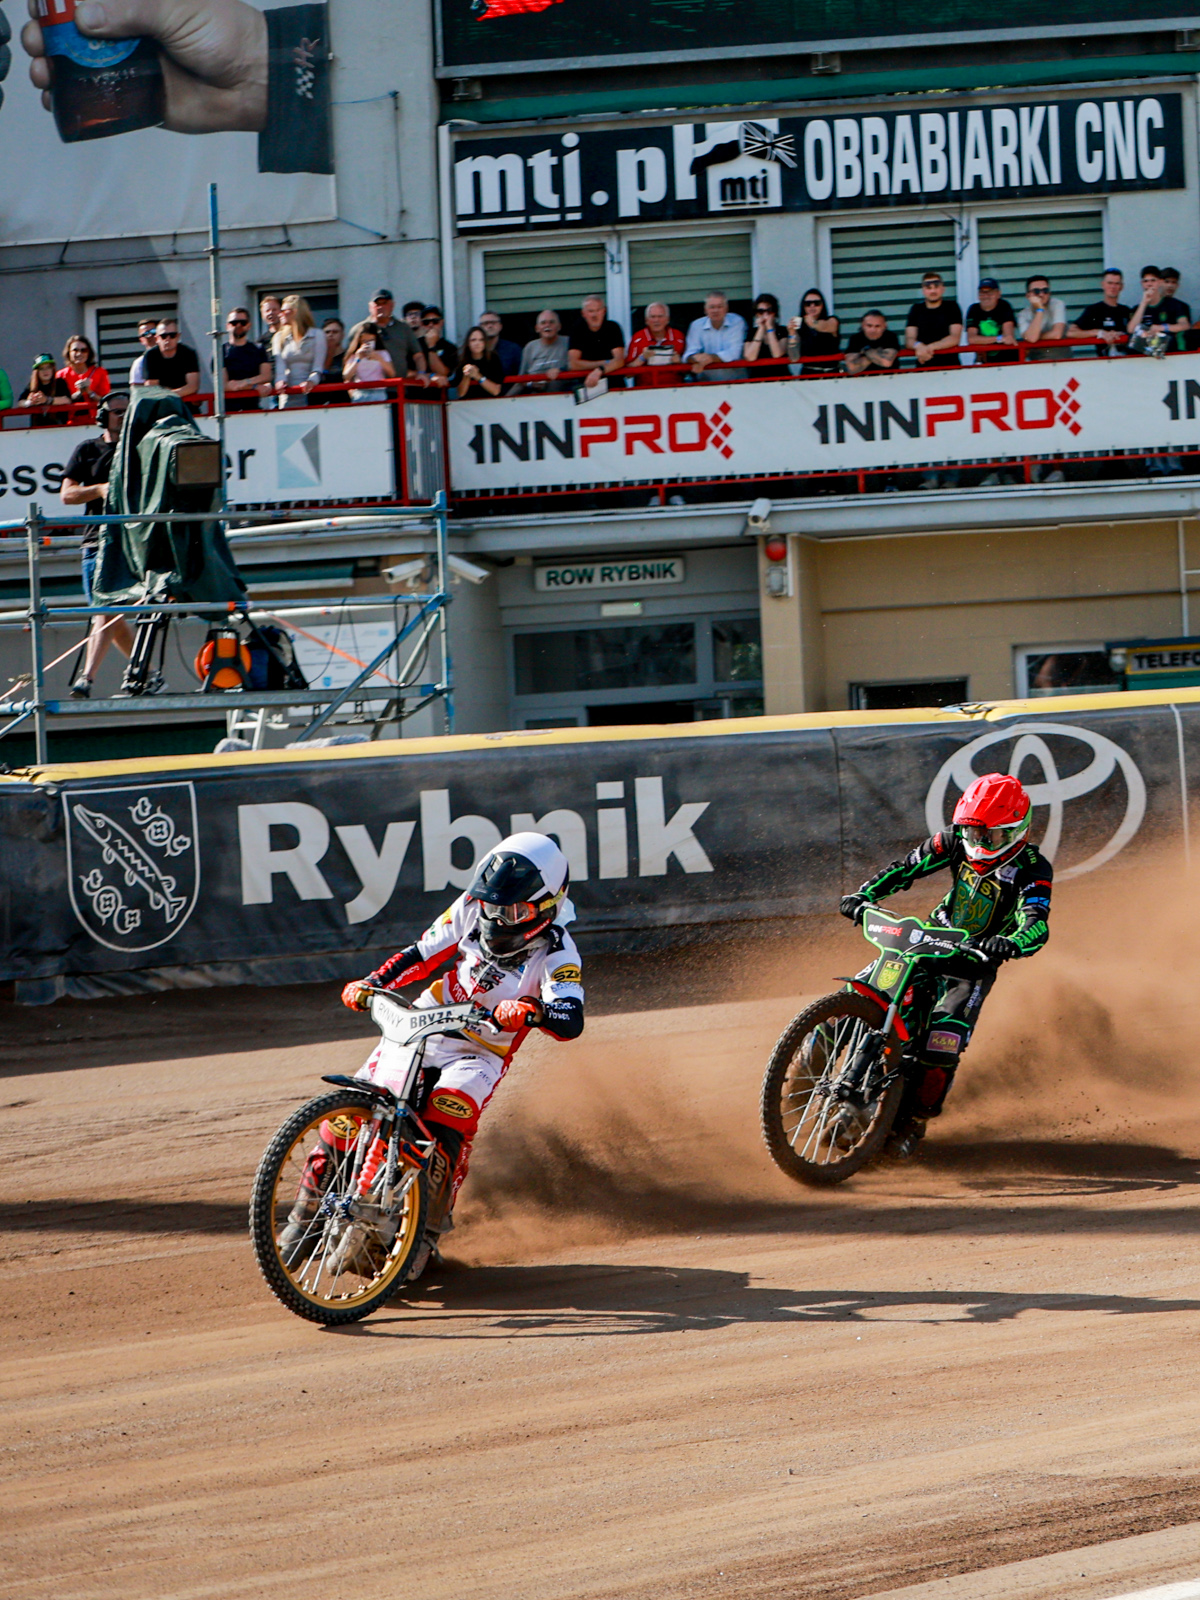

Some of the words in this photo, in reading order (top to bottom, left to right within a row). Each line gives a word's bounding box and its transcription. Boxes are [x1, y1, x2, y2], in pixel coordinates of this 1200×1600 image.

[804, 105, 1061, 200] OBRABIARKI
[1075, 98, 1165, 183] CNC
[719, 168, 769, 202] mti
[468, 411, 713, 464] INNPRO
[812, 388, 1058, 446] INNPRO
[545, 566, 595, 587] ROW
[600, 561, 676, 584] RYBNIK
[237, 776, 715, 925] Rybnik
[378, 1002, 404, 1029] RYNNY
[410, 1010, 455, 1030] BRYZA
[435, 1097, 471, 1116] SZIK
